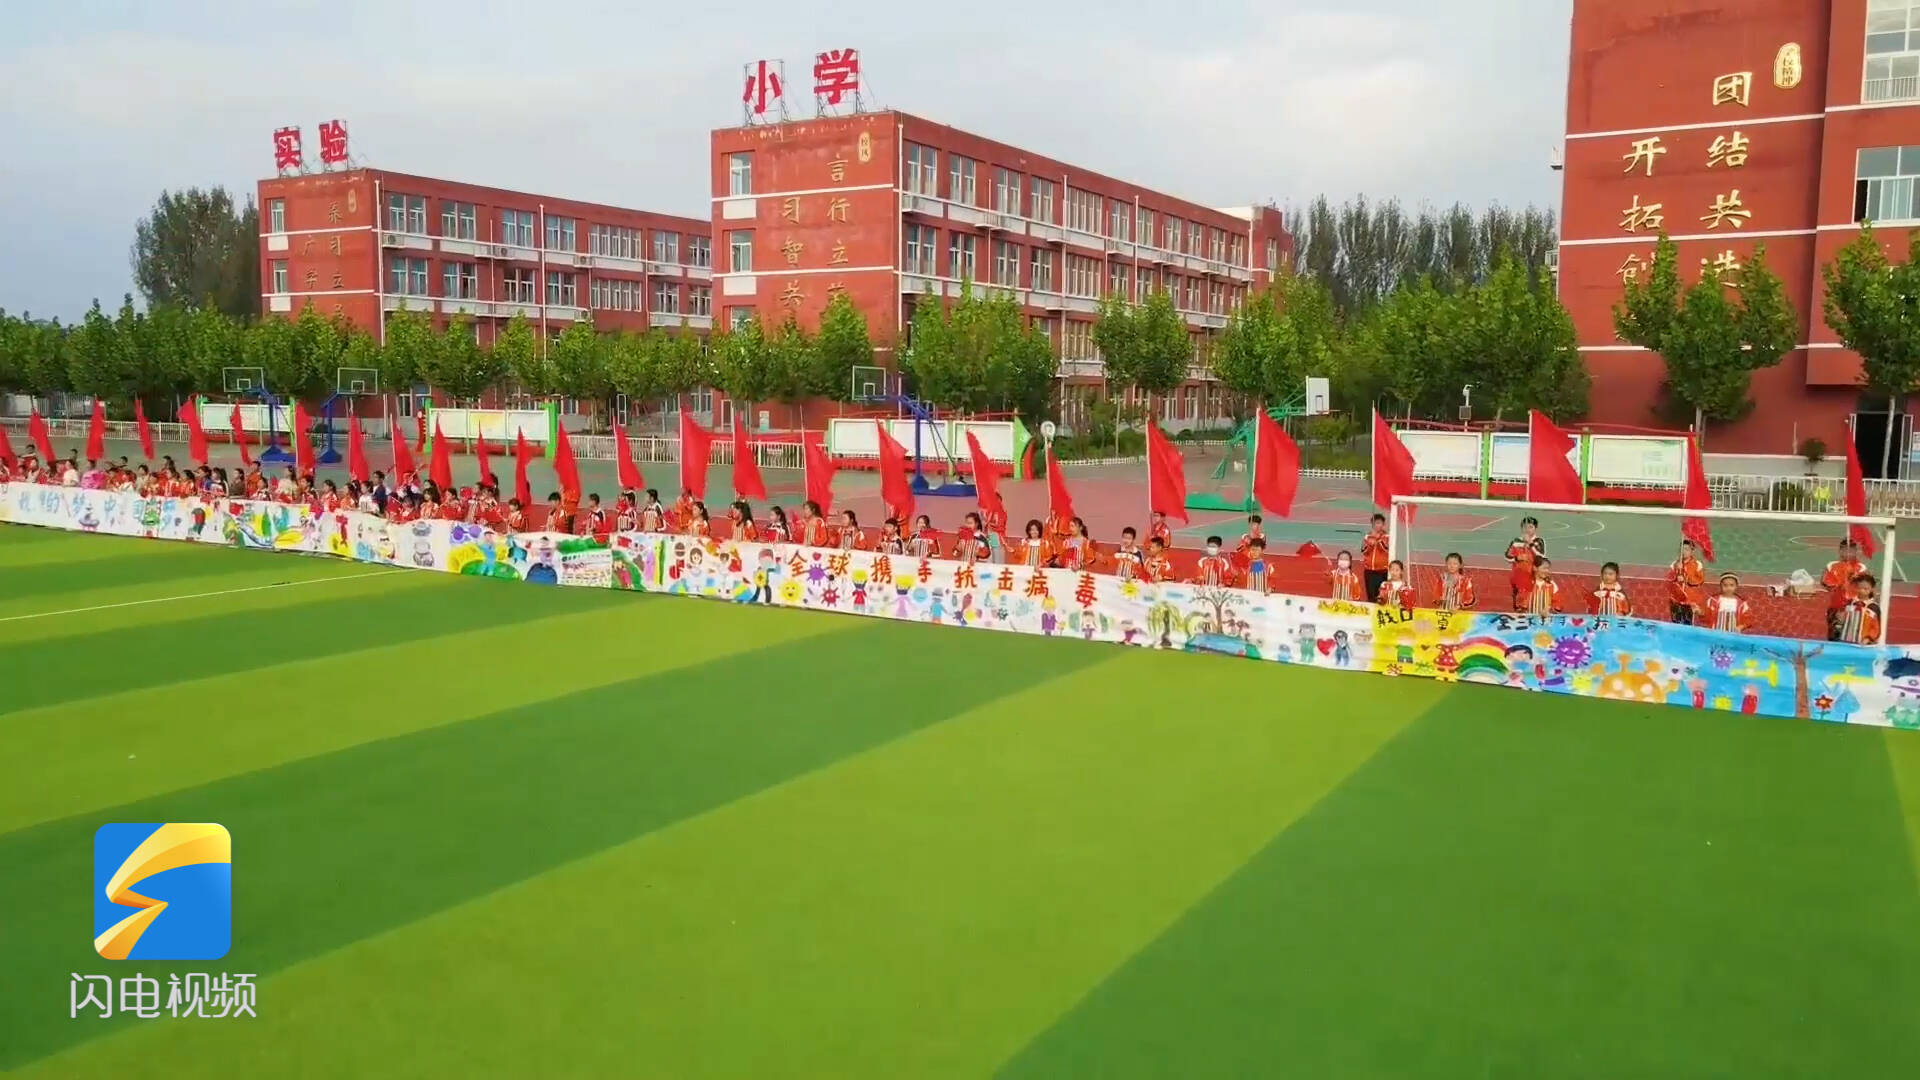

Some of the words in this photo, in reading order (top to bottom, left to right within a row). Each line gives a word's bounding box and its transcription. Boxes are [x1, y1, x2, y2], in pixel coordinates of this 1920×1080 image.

[743, 48, 859, 114] 小学
[273, 120, 348, 169] 实验
[787, 552, 1098, 608] 全球携手抗击病毒
